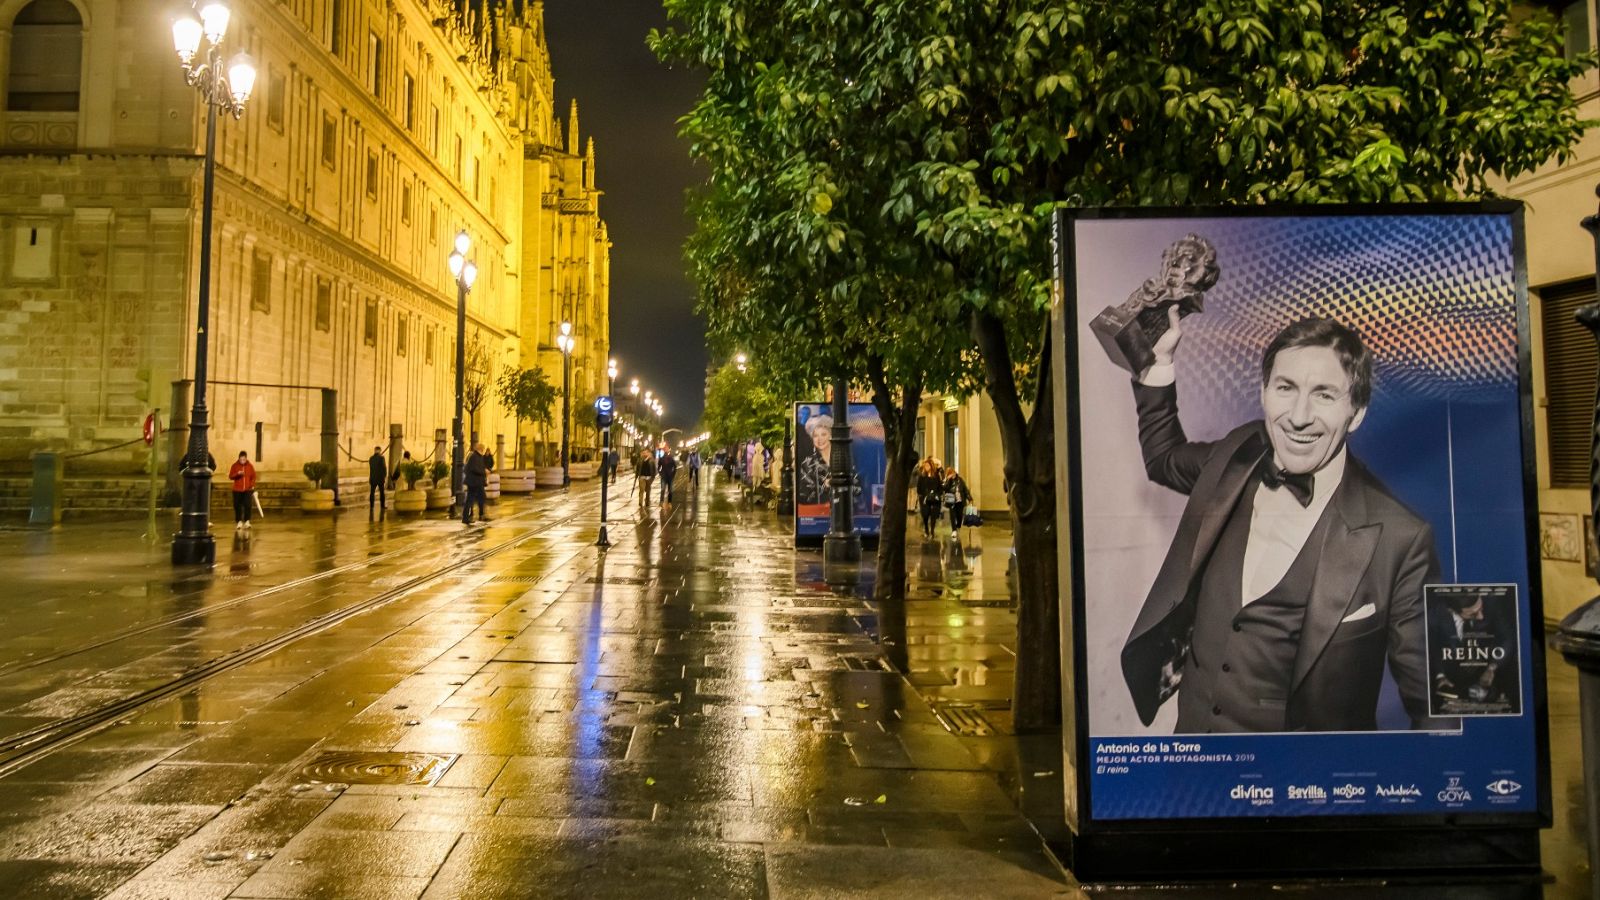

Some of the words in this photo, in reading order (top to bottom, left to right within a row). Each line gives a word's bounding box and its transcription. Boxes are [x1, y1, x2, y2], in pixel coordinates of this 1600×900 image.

[1467, 639, 1478, 647] EL
[1442, 647, 1505, 660] REINO
[1096, 743, 1140, 754] Antonio
[1142, 742, 1157, 753] de
[1160, 742, 1170, 753] la
[1172, 742, 1201, 752] Torre
[1096, 755, 1127, 764] MEJOR
[1130, 755, 1160, 763] ACTOR
[1163, 754, 1233, 763] PROTAGONISTA
[1235, 753, 1255, 762] 2019
[1096, 765, 1105, 774] El
[1107, 765, 1129, 774] reino
[1230, 784, 1274, 799] divina
[1437, 790, 1472, 802] GOYA
